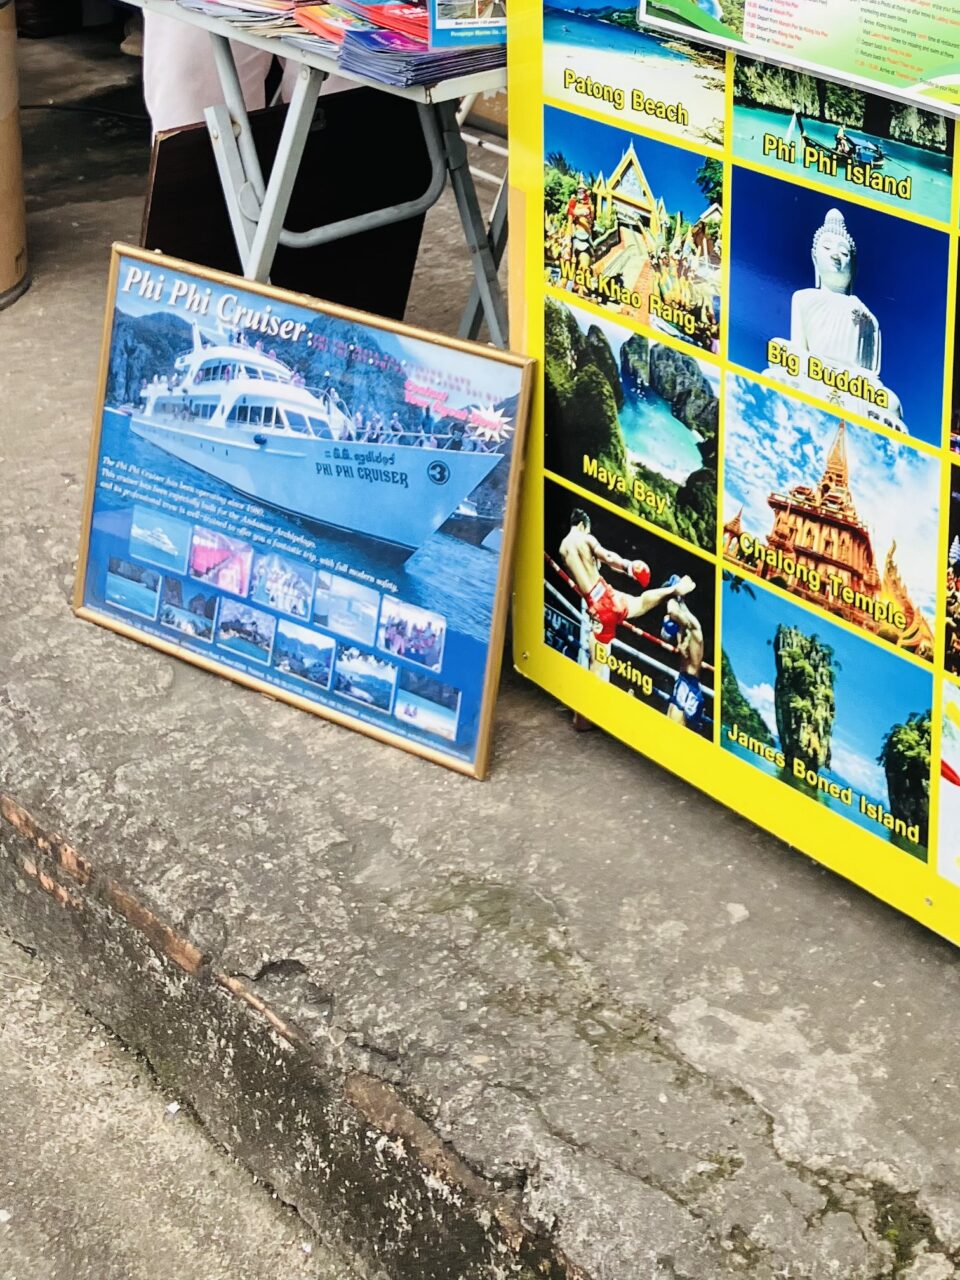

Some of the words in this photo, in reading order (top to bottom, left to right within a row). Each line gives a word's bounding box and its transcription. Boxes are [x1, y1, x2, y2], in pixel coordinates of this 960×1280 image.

[564, 68, 625, 111] Patong
[631, 88, 689, 126] Beach
[763, 132, 796, 164] Phi
[803, 145, 837, 178] Phi
[845, 161, 912, 201] island
[121, 265, 166, 302] Phi
[167, 278, 213, 315] Phi
[560, 257, 592, 289] Wat
[598, 272, 642, 309] Khao
[649, 293, 696, 335] Rang
[767, 339, 800, 377] Big
[807, 352, 890, 410] Buddha
[316, 462, 333, 477] PHI
[336, 464, 354, 479] PHI
[357, 466, 409, 489] CRUISER
[429, 463, 446, 483] 3
[582, 454, 627, 494] Maya
[632, 478, 668, 516] Bay
[738, 532, 826, 594] Chalong
[828, 573, 908, 631] Temple
[595, 642, 654, 696] Boxing
[727, 723, 786, 769] James
[792, 759, 853, 809] Boned
[859, 792, 921, 846] Island
